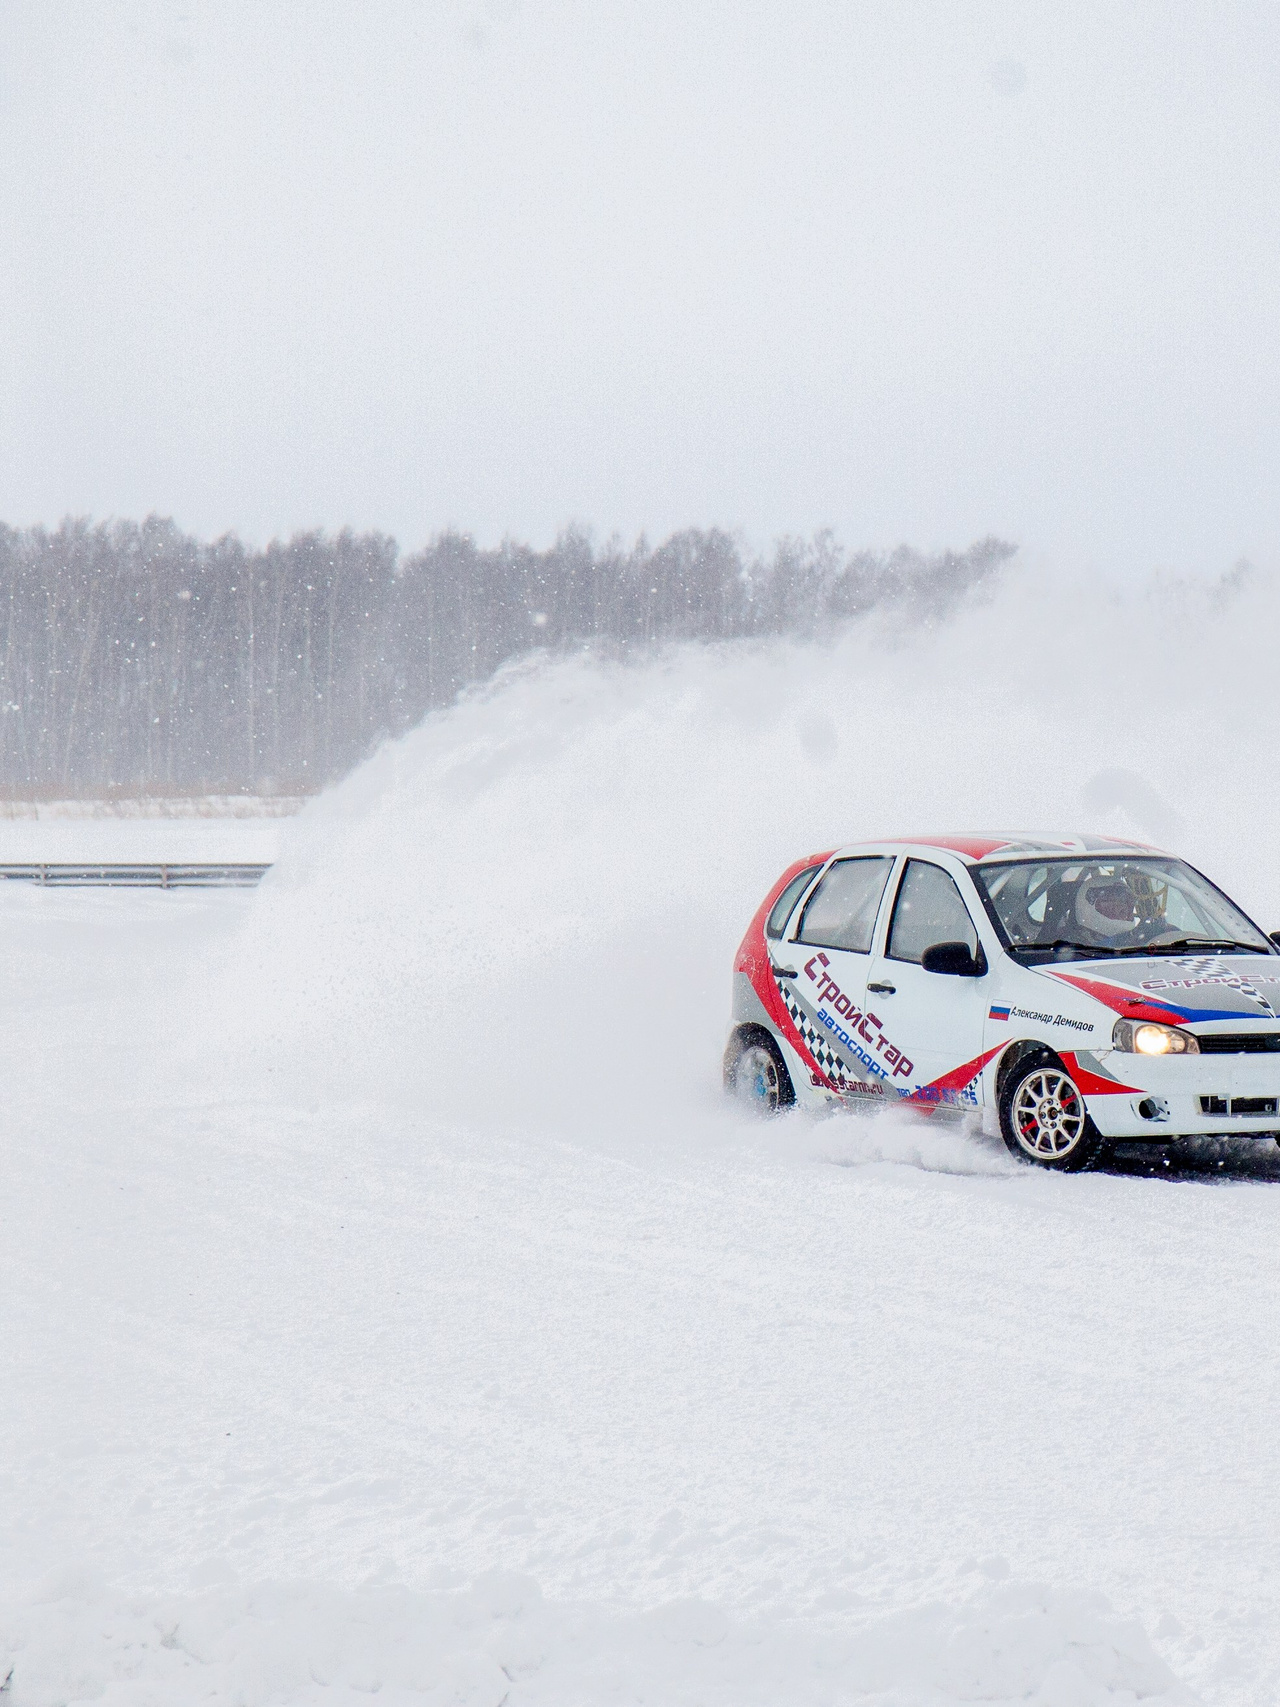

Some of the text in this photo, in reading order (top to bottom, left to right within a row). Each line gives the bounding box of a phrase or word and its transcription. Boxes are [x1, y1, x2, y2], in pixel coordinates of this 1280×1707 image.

[804, 952, 914, 1078] СтройСтар
[817, 1008, 889, 1080] автоспорт
[1010, 1006, 1094, 1032] Александр Демидов
